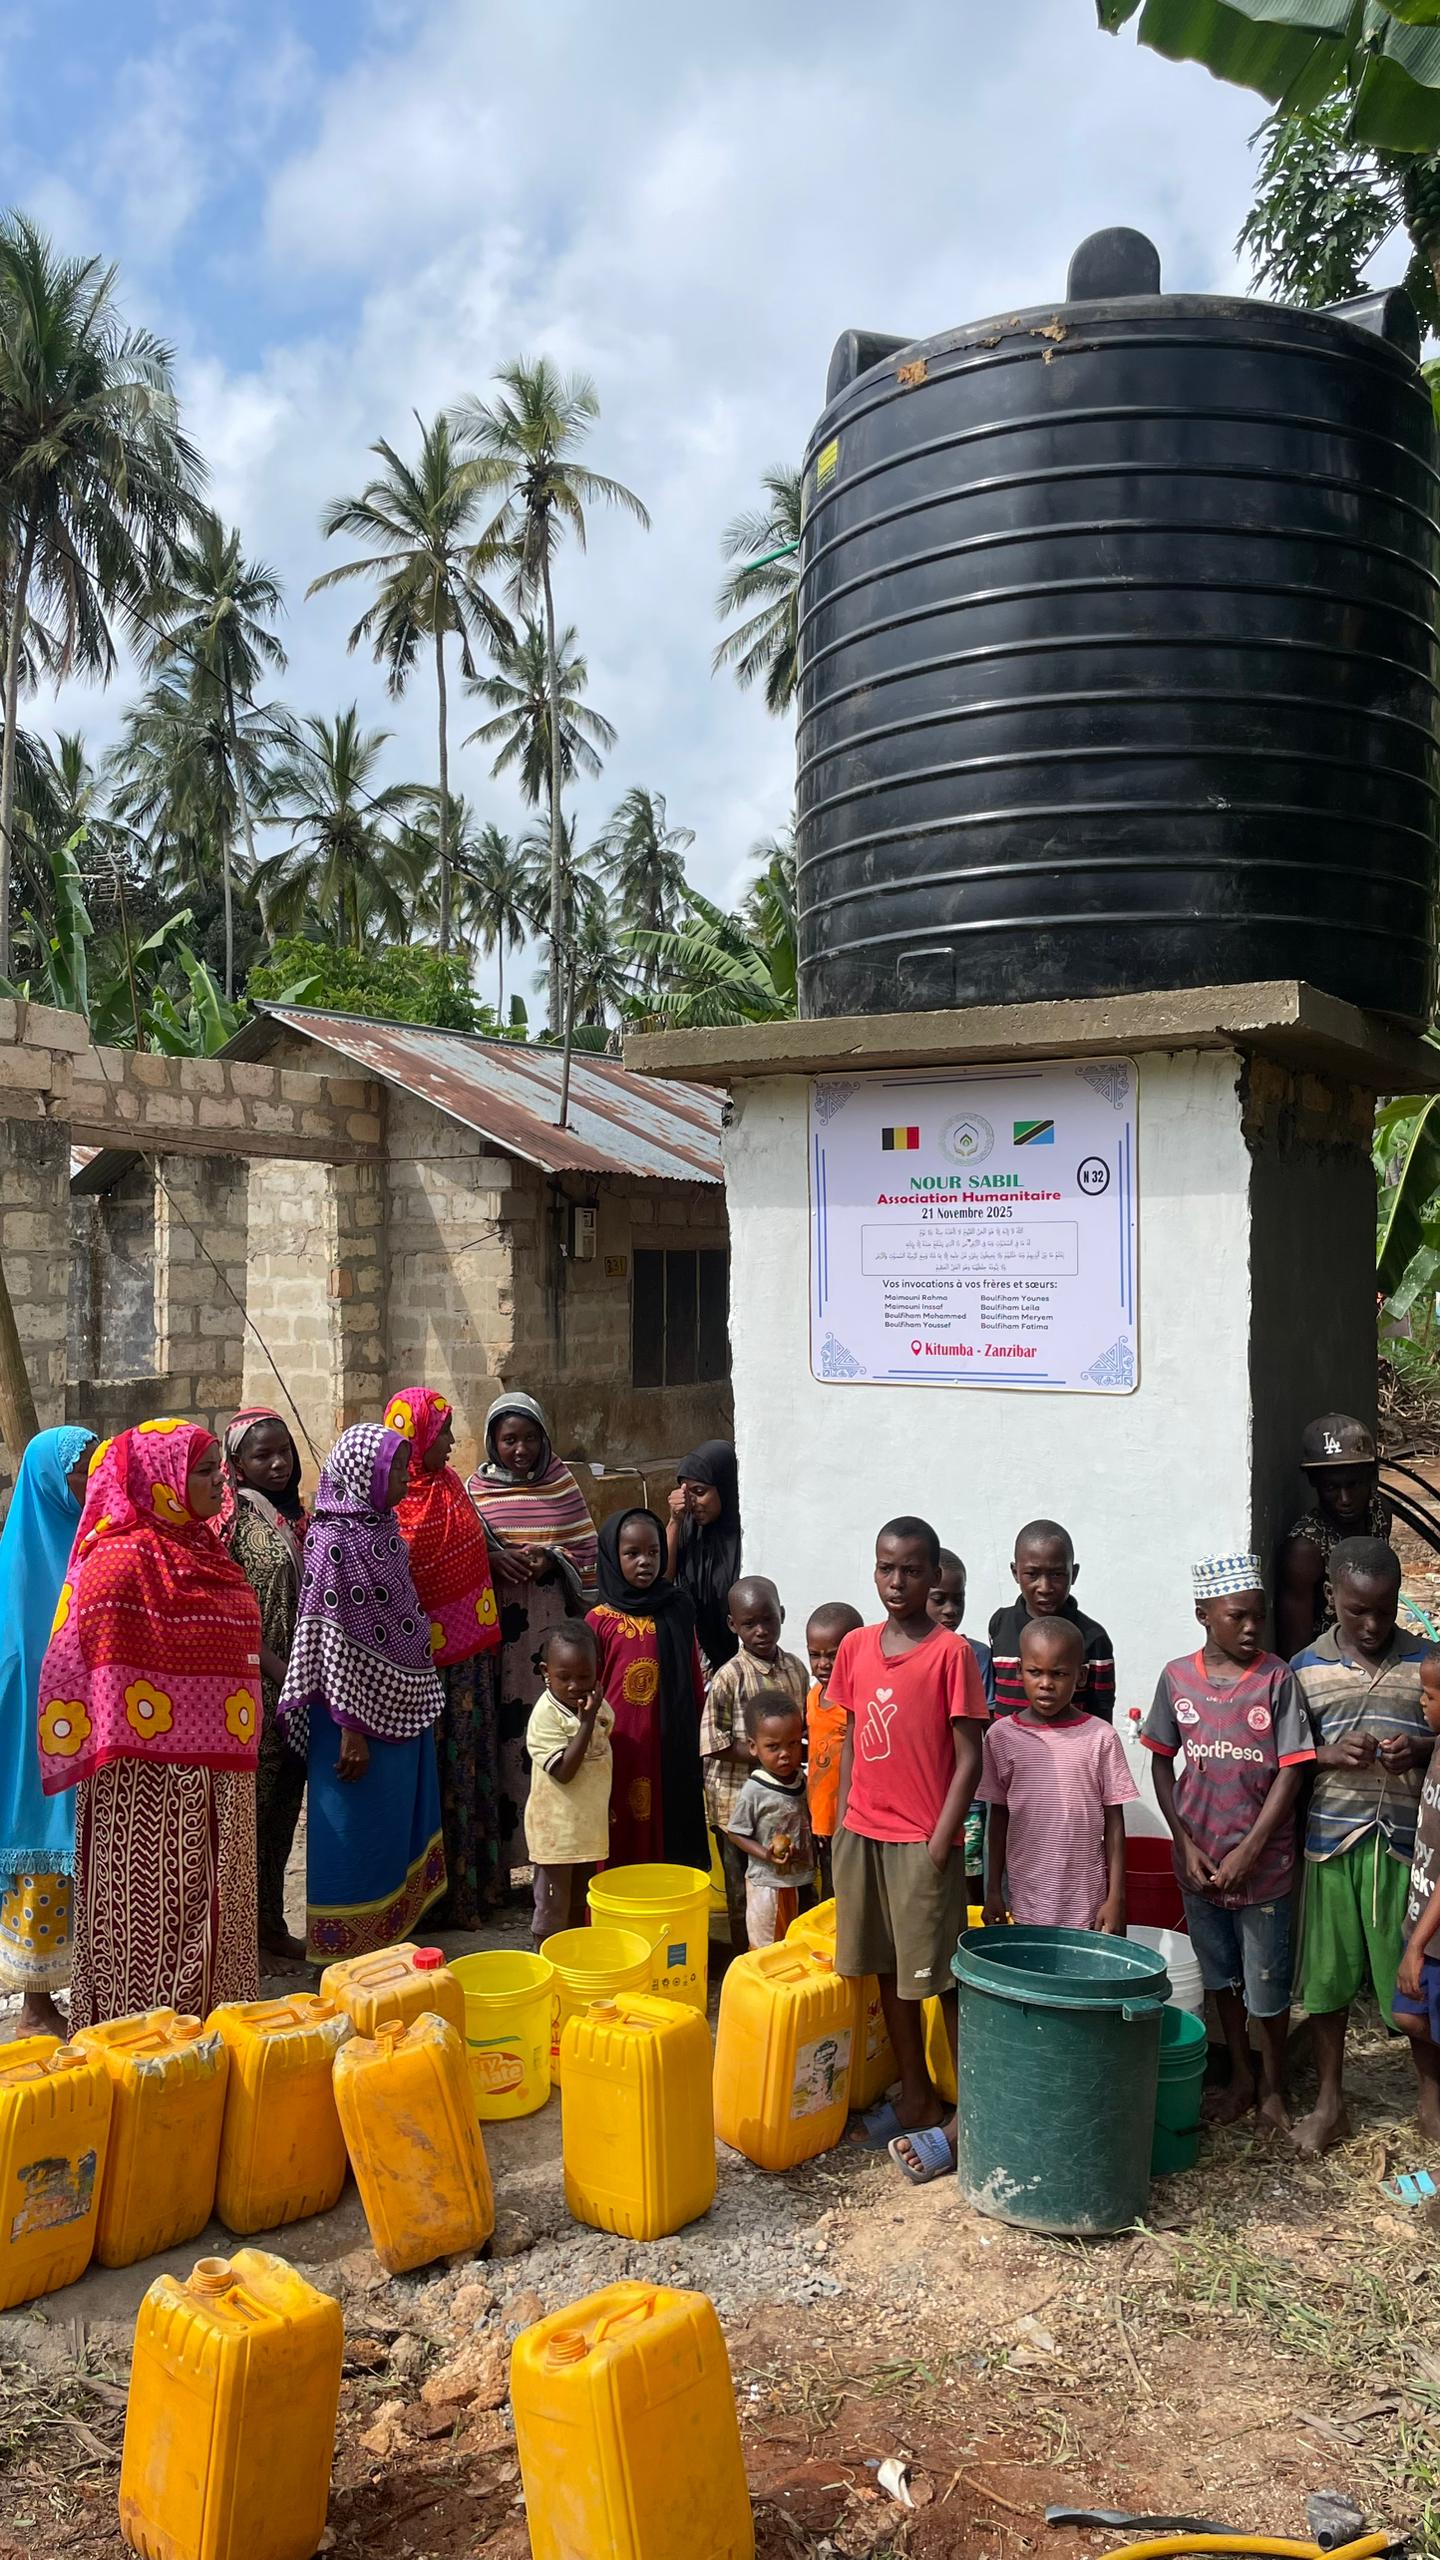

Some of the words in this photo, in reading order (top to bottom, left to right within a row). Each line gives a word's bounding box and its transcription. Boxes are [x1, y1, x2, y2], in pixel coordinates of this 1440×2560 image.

[910, 1176, 961, 1190] NOUR
[968, 1174, 1024, 1188] SABIL
[1083, 1170, 1089, 1183] N
[1092, 1170, 1104, 1183] 32
[877, 1192, 957, 1205] Association
[962, 1190, 1061, 1203] Humanitaire
[921, 1208, 933, 1219] 21
[937, 1206, 983, 1219] Novembre
[987, 1206, 1012, 1219] 2025
[882, 1279, 900, 1288] Vos
[901, 1279, 954, 1288] invocations
[956, 1279, 963, 1288] à
[983, 1279, 1011, 1289] frères
[1013, 1279, 1023, 1288] et
[1025, 1280, 1057, 1289] sœurs:
[922, 1312, 967, 1320] Mohammed
[1021, 1314, 1053, 1322] Meryem
[922, 1321, 951, 1329] Youssef
[925, 1343, 974, 1356] Kitumba
[984, 1344, 1037, 1358] Zanzibar
[1323, 1431, 1343, 1454] LA
[1186, 1739, 1264, 1763] SportPesa
